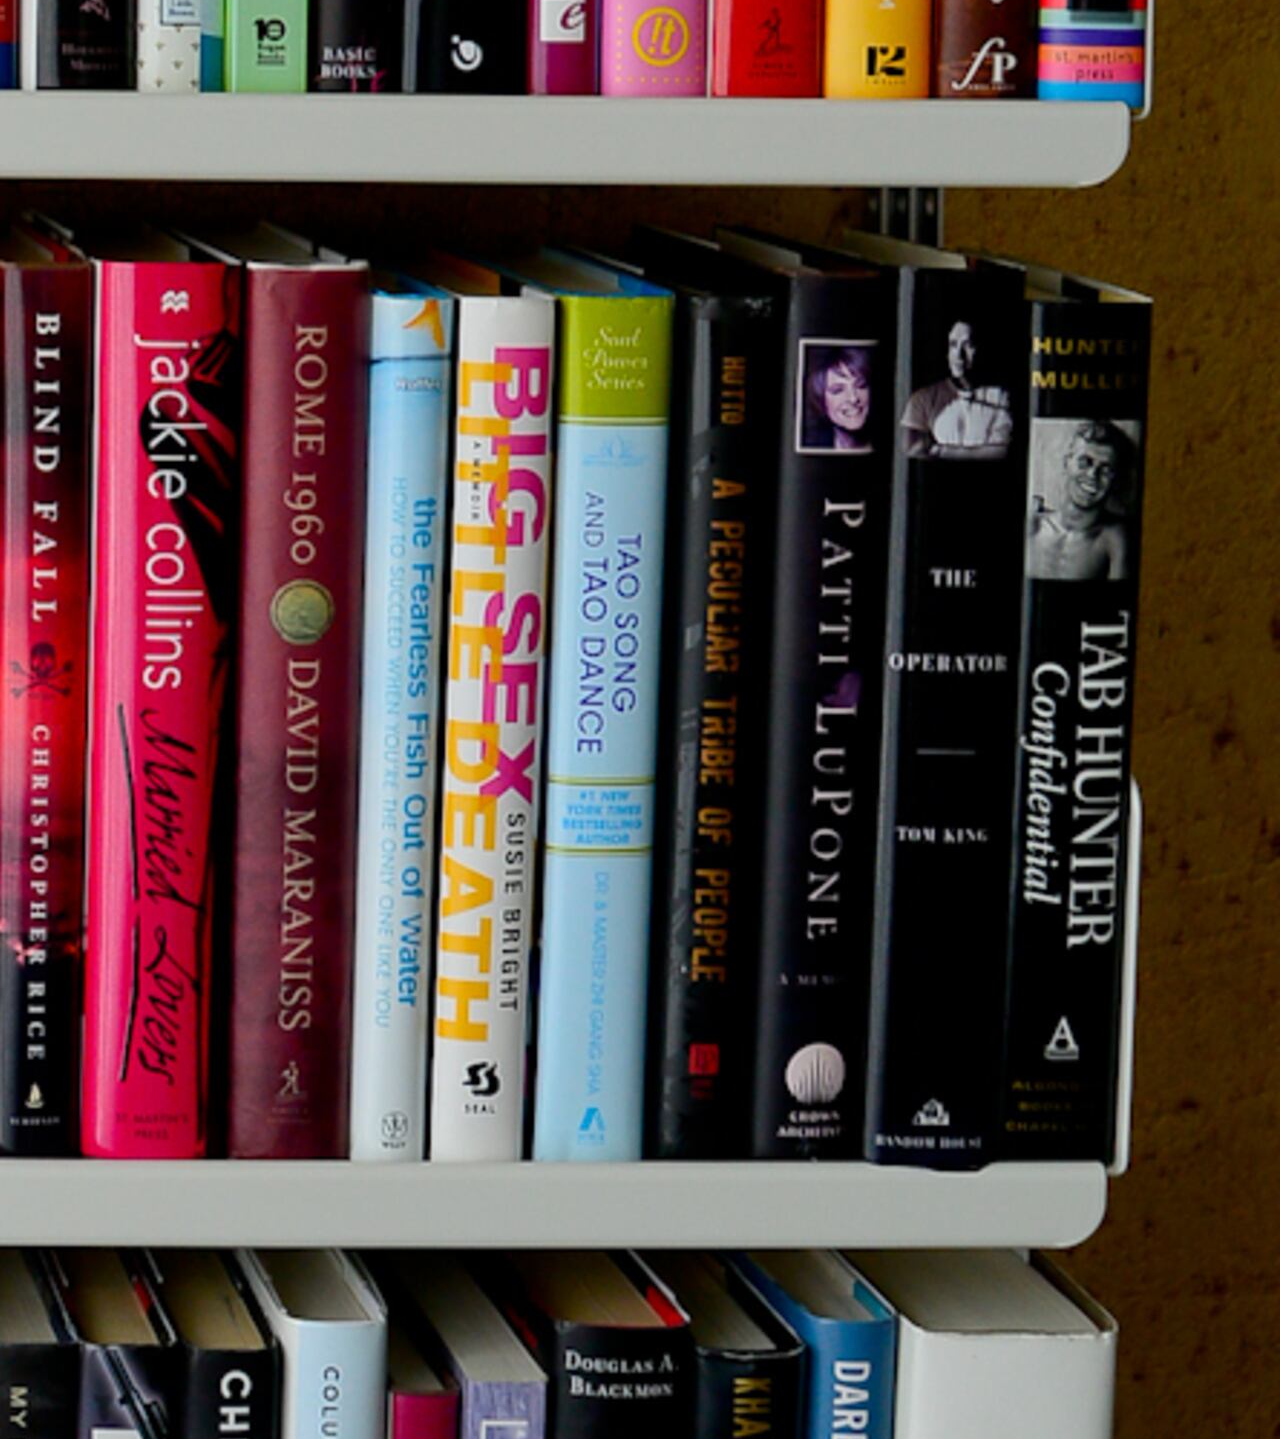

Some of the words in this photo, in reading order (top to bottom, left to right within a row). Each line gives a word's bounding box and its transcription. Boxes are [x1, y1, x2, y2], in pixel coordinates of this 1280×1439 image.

[292, 323, 331, 459] ROME
[285, 473, 328, 567] 1960
[929, 569, 976, 589] THE
[888, 653, 1007, 672] OPERATOR
[504, 814, 528, 895] SUSIE
[896, 826, 935, 844] TOM
[942, 826, 988, 844] KING
[496, 909, 521, 1011] BRIGHT
